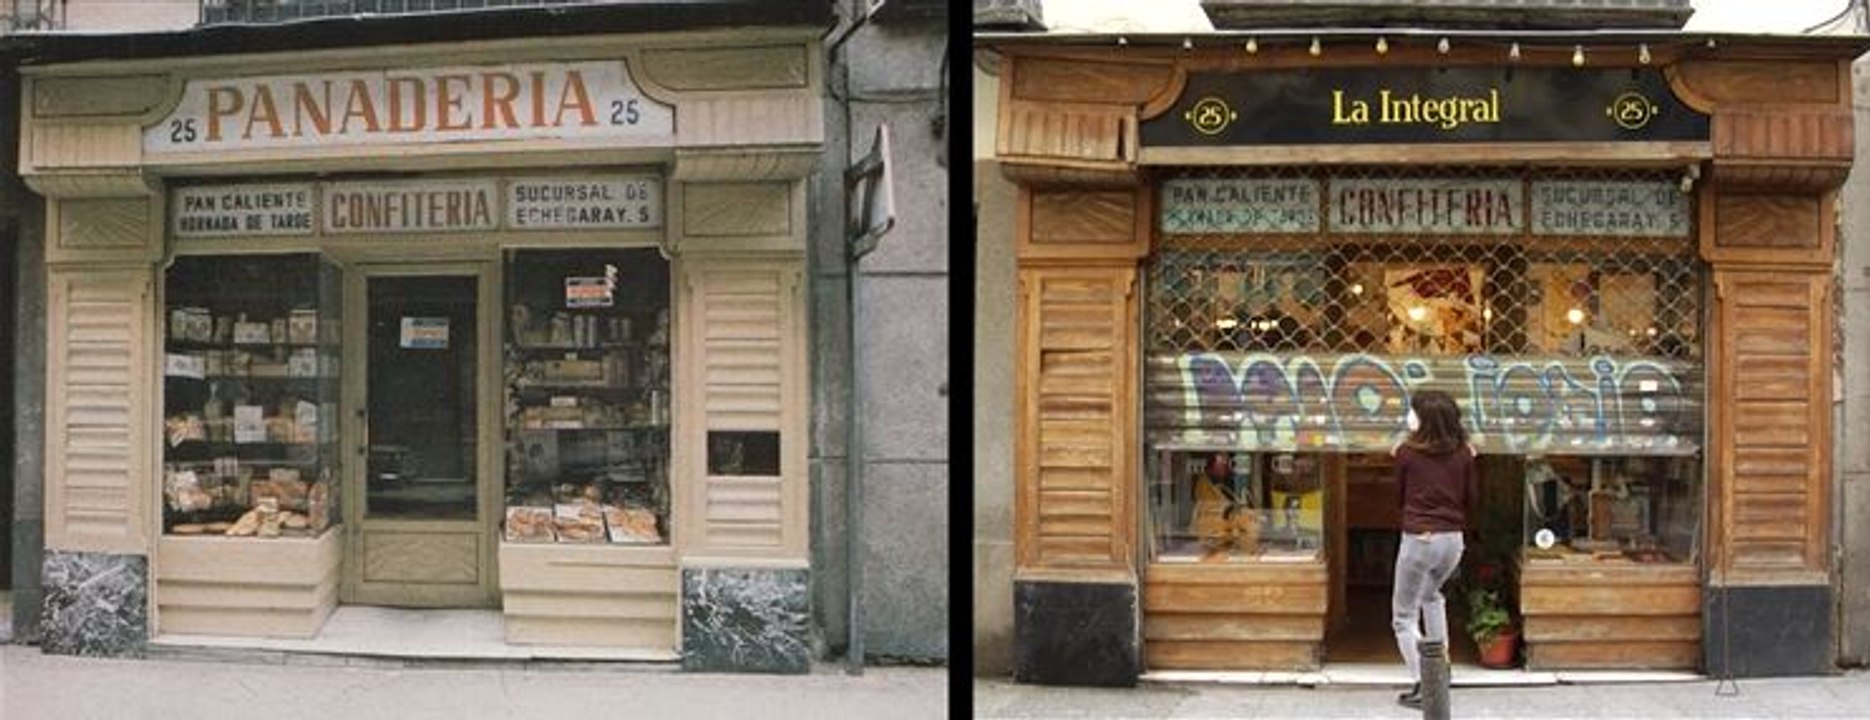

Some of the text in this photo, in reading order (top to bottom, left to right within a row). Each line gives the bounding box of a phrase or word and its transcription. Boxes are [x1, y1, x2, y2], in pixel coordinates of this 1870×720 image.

[171, 70, 639, 143] 25 PANADERIA 25
[1200, 105, 1221, 125] 25
[1332, 88, 1499, 129] La Integral
[1621, 101, 1643, 120] 25
[184, 191, 304, 212] PAN CALIENTE
[516, 182, 648, 202] SUCURSAL DE
[332, 189, 492, 228] CONFITERIA
[1340, 188, 1513, 227] CONFITERIA
[246, 214, 262, 230] DE
